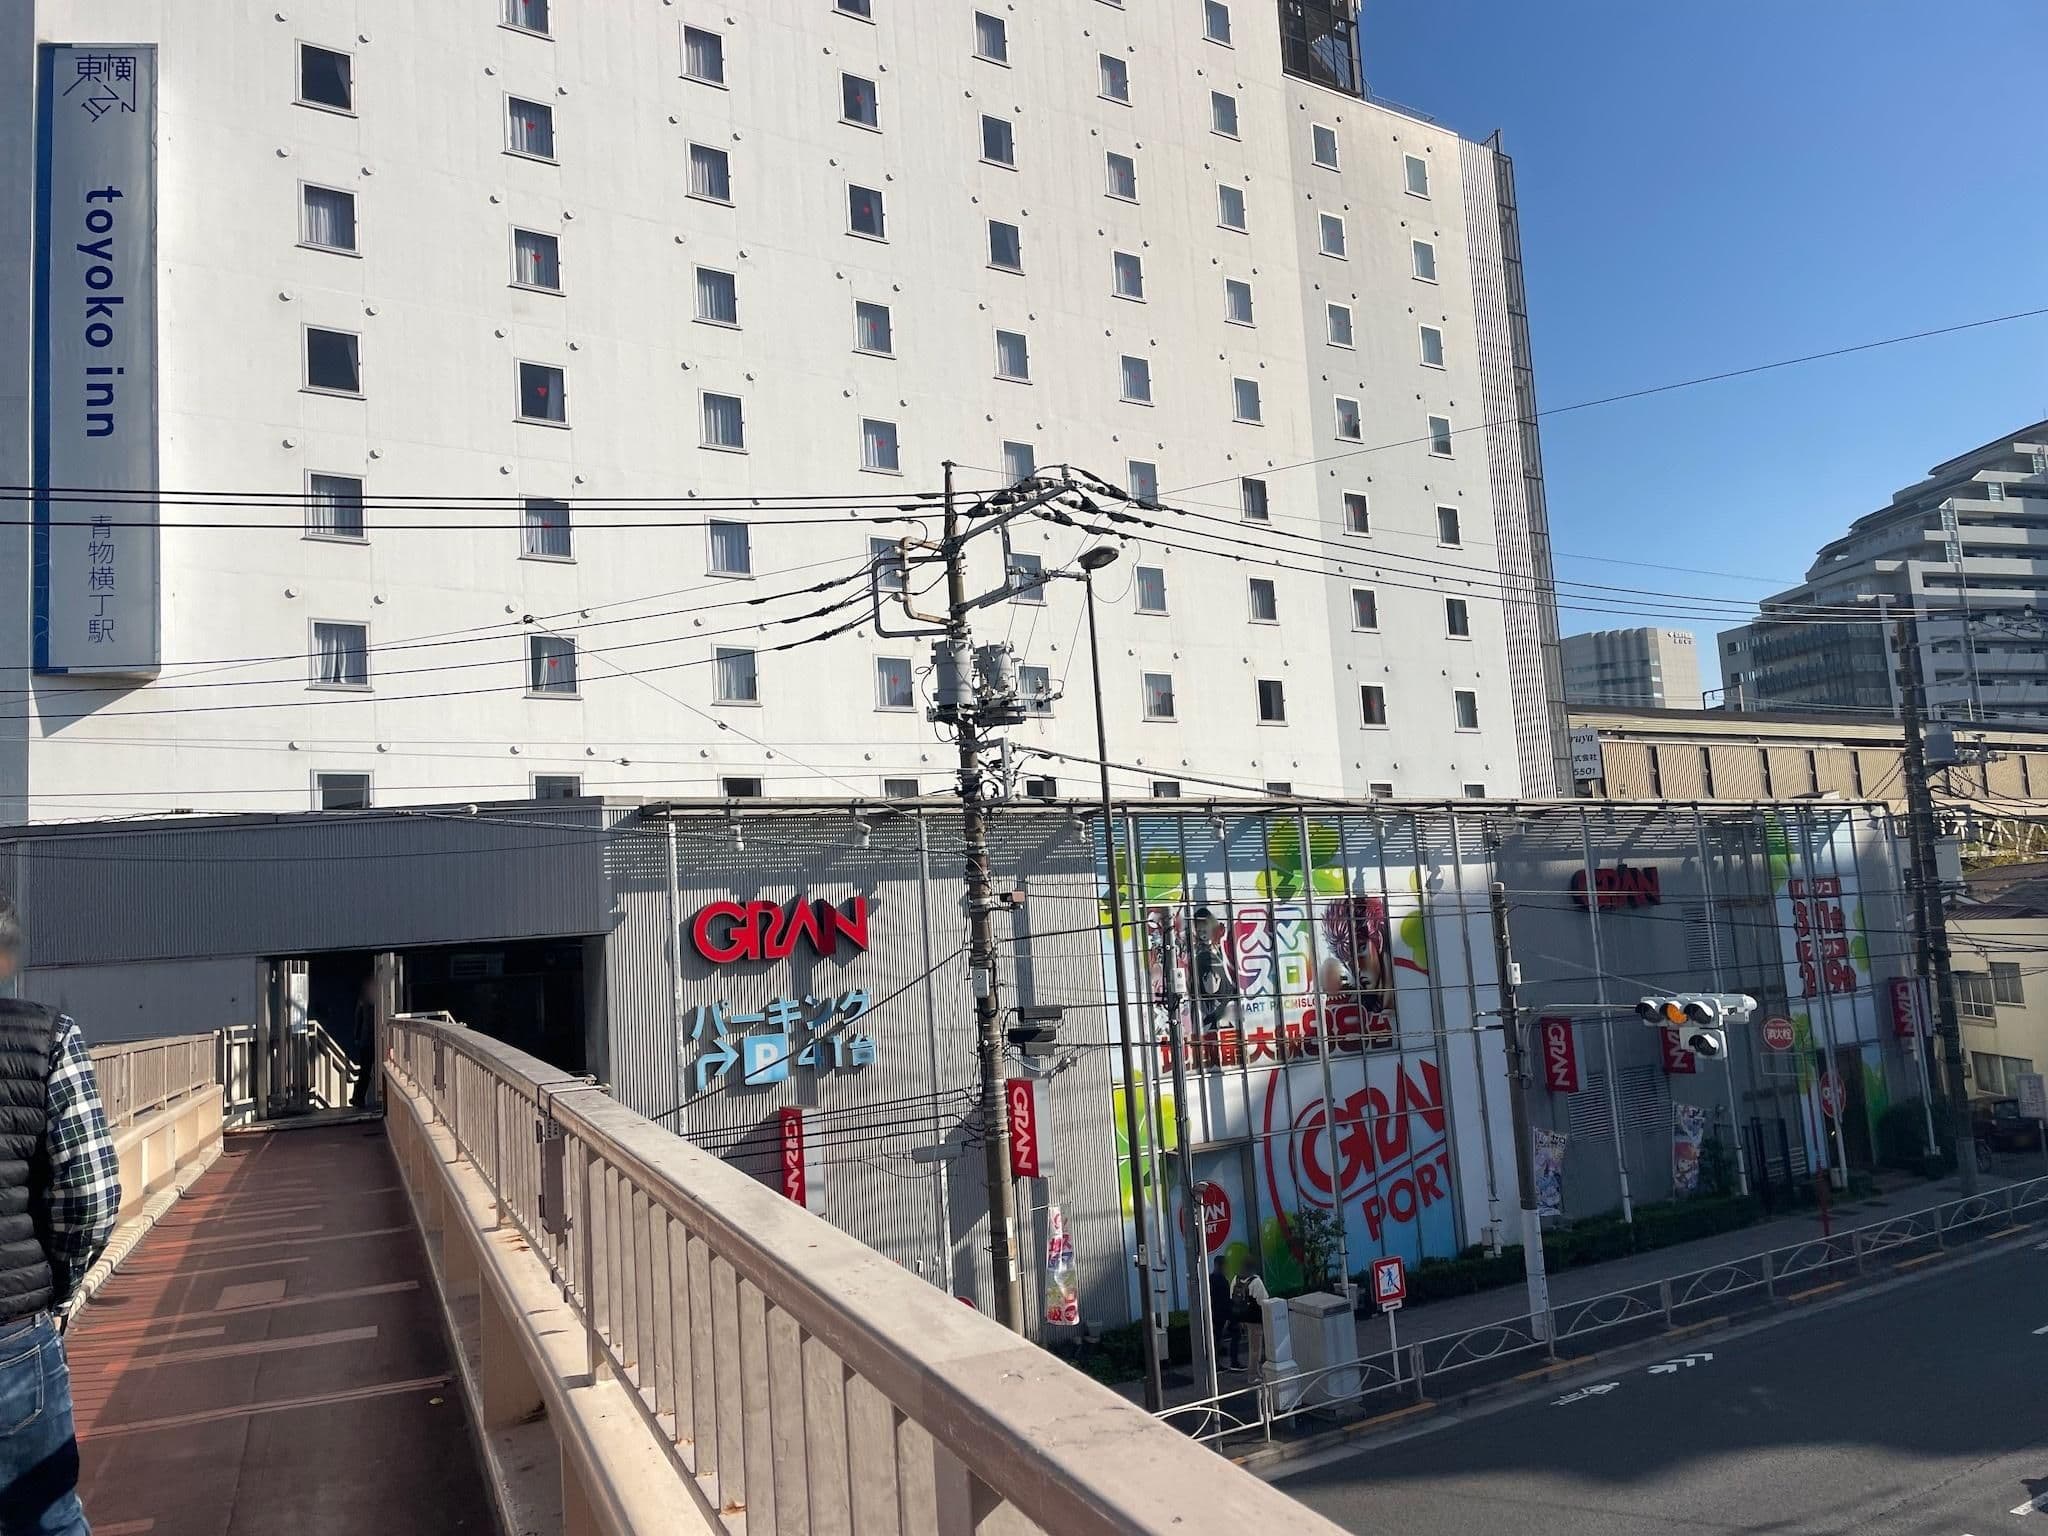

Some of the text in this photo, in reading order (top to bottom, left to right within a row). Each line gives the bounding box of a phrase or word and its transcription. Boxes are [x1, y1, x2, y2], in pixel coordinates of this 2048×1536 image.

[76, 185, 125, 437] toyoko inn
[88, 515, 115, 643] 青物横丁駅
[693, 895, 869, 964] GRAN
[691, 987, 872, 1040] パーキング
[755, 1042, 778, 1076] P
[1548, 1023, 1570, 1086] GRAN
[1013, 1086, 1033, 1169] GRAN
[1302, 1059, 1446, 1194] GRAN
[1205, 1201, 1225, 1220] AN
[1206, 1223, 1218, 1234] RT
